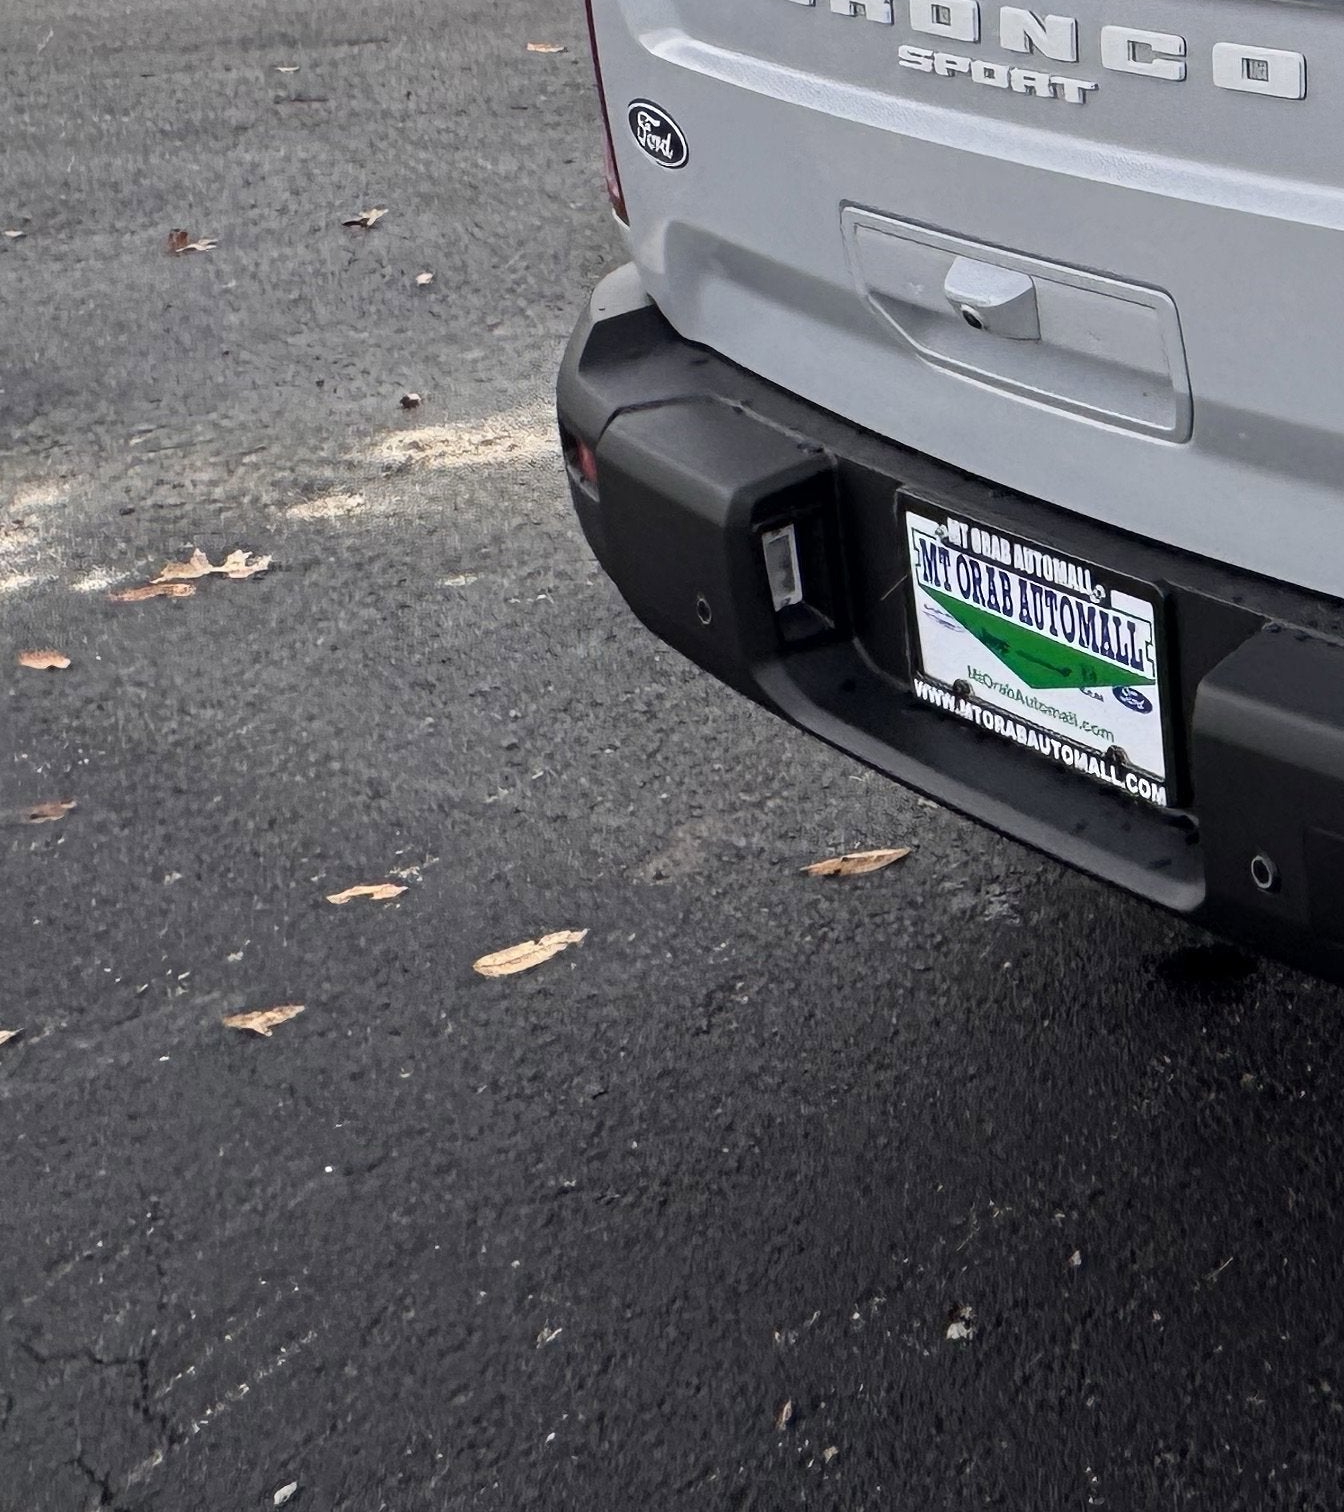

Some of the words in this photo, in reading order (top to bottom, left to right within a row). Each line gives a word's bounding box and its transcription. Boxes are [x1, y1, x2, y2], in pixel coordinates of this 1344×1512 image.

[897, 45, 1099, 104] SPORT
[633, 107, 678, 163] Ford
[970, 527, 1012, 565] ORAB
[1013, 543, 1092, 596] AUTOMALL
[919, 538, 952, 592] MT
[956, 553, 1014, 618] ORAB
[1019, 579, 1145, 673] AUTOMALL
[913, 678, 1167, 807] WWW.MTORABAUTOMALL.COM
